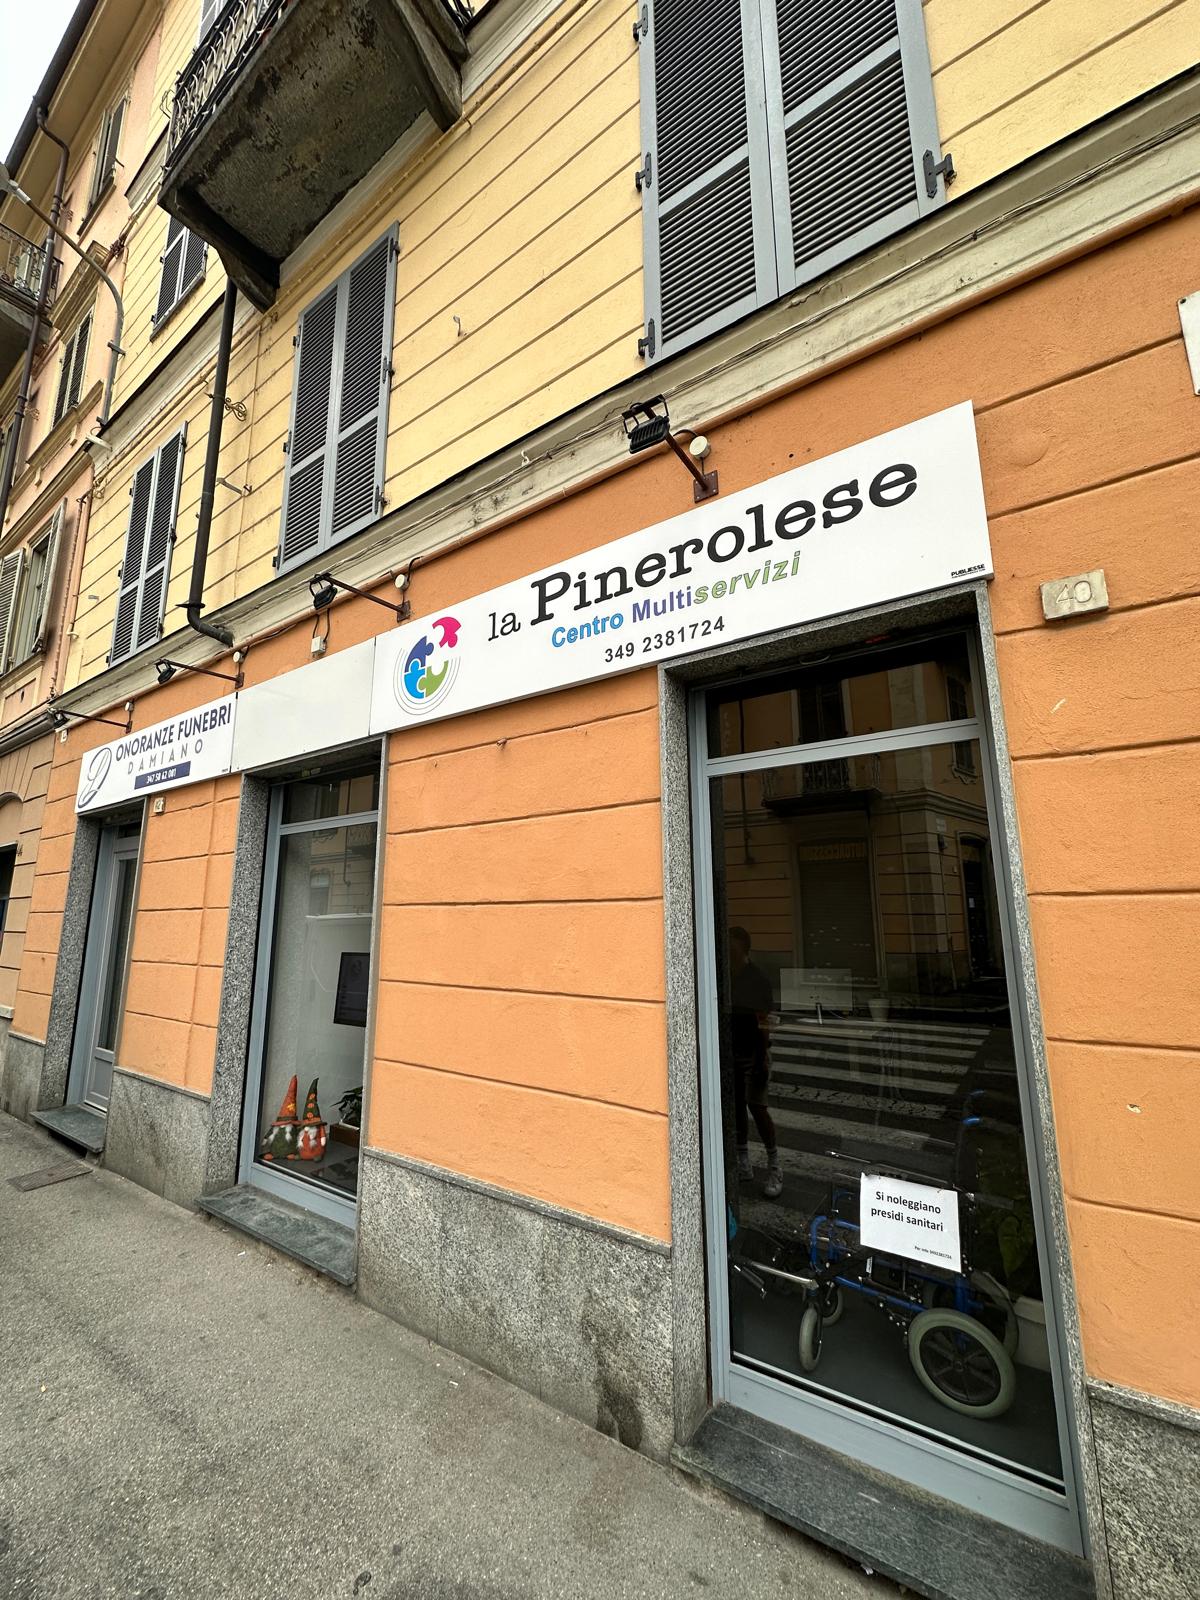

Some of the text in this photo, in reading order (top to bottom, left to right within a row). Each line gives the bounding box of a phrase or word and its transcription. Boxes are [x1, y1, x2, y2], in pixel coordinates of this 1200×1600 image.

[488, 463, 918, 641] la Pinerolese
[551, 551, 801, 648] Centro Multiservizi
[1056, 580, 1092, 608] 40
[605, 615, 726, 663] 349 2381724
[115, 703, 232, 762] ONORANZE FUNEBRI
[127, 738, 203, 775] DAMIANO
[871, 1207, 943, 1232] presidi sanitari
[875, 1191, 941, 1214] Si noleggiano
